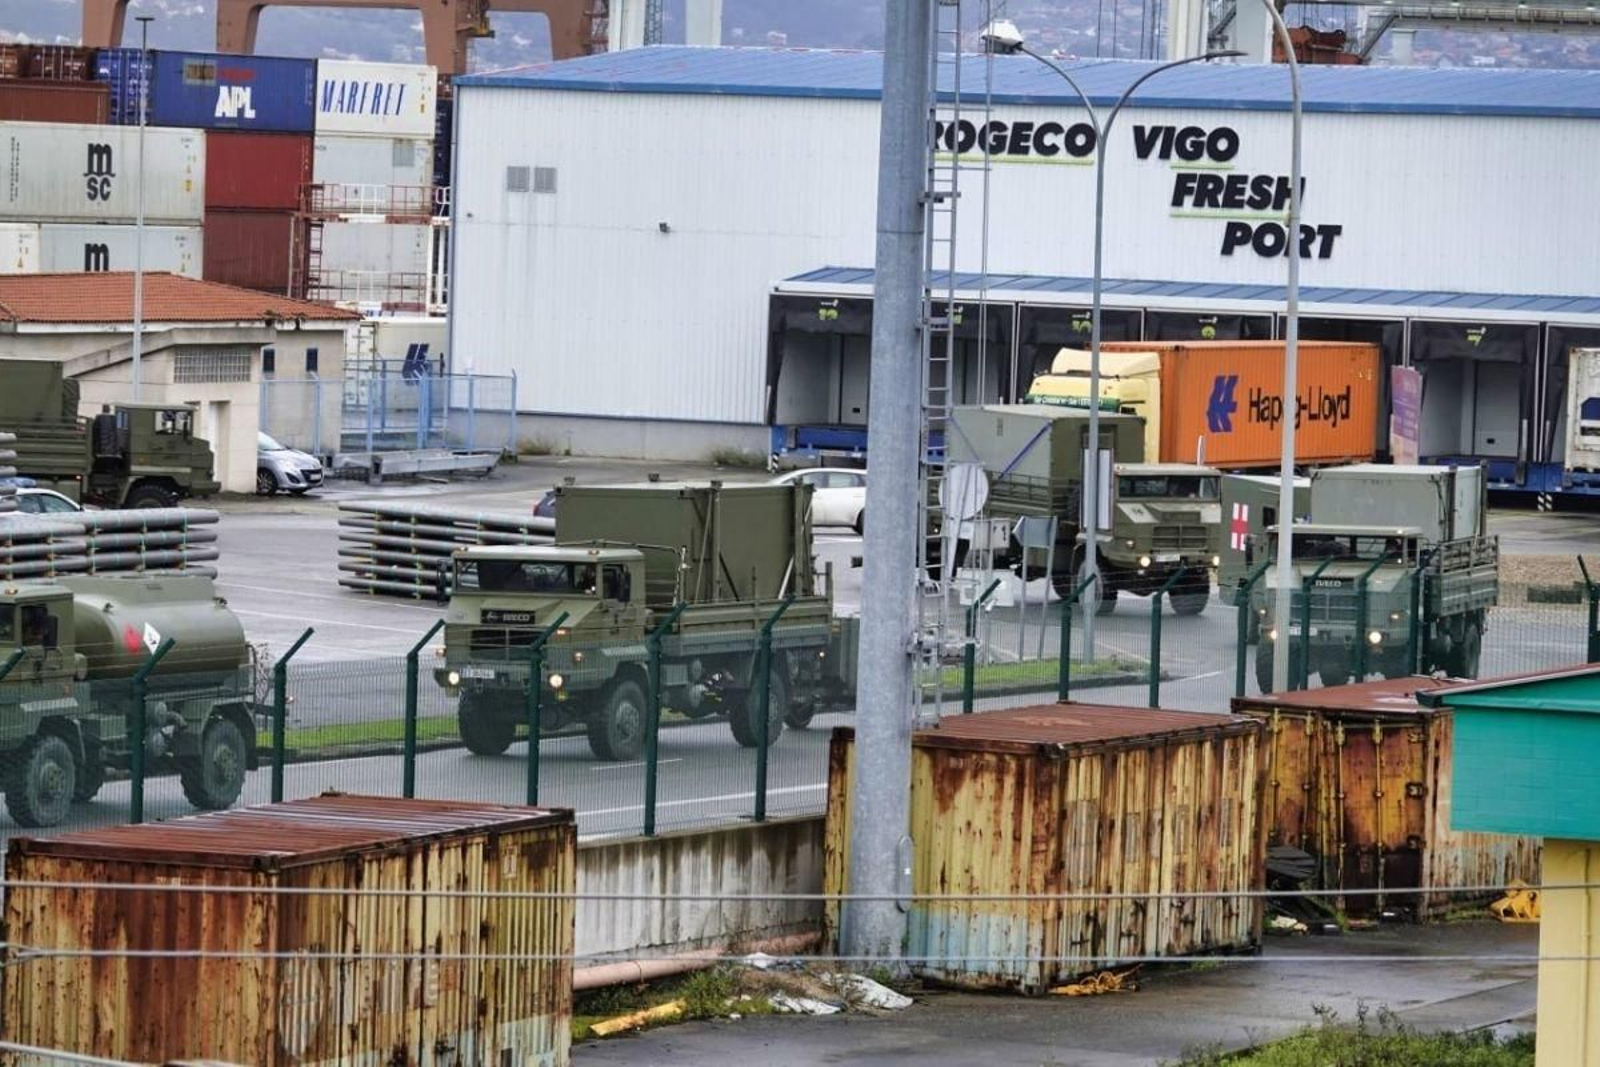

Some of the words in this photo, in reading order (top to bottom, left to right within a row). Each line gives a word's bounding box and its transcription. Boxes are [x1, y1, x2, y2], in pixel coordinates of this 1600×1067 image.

[214, 86, 256, 119] APL
[321, 80, 406, 116] MARFRET
[1132, 126, 1240, 162] VIGO
[1171, 173, 1306, 210] FRESH
[1220, 221, 1343, 259] PORT
[1249, 385, 1351, 431] Hapg-Lloyd
[1315, 579, 1342, 588] IVECO
